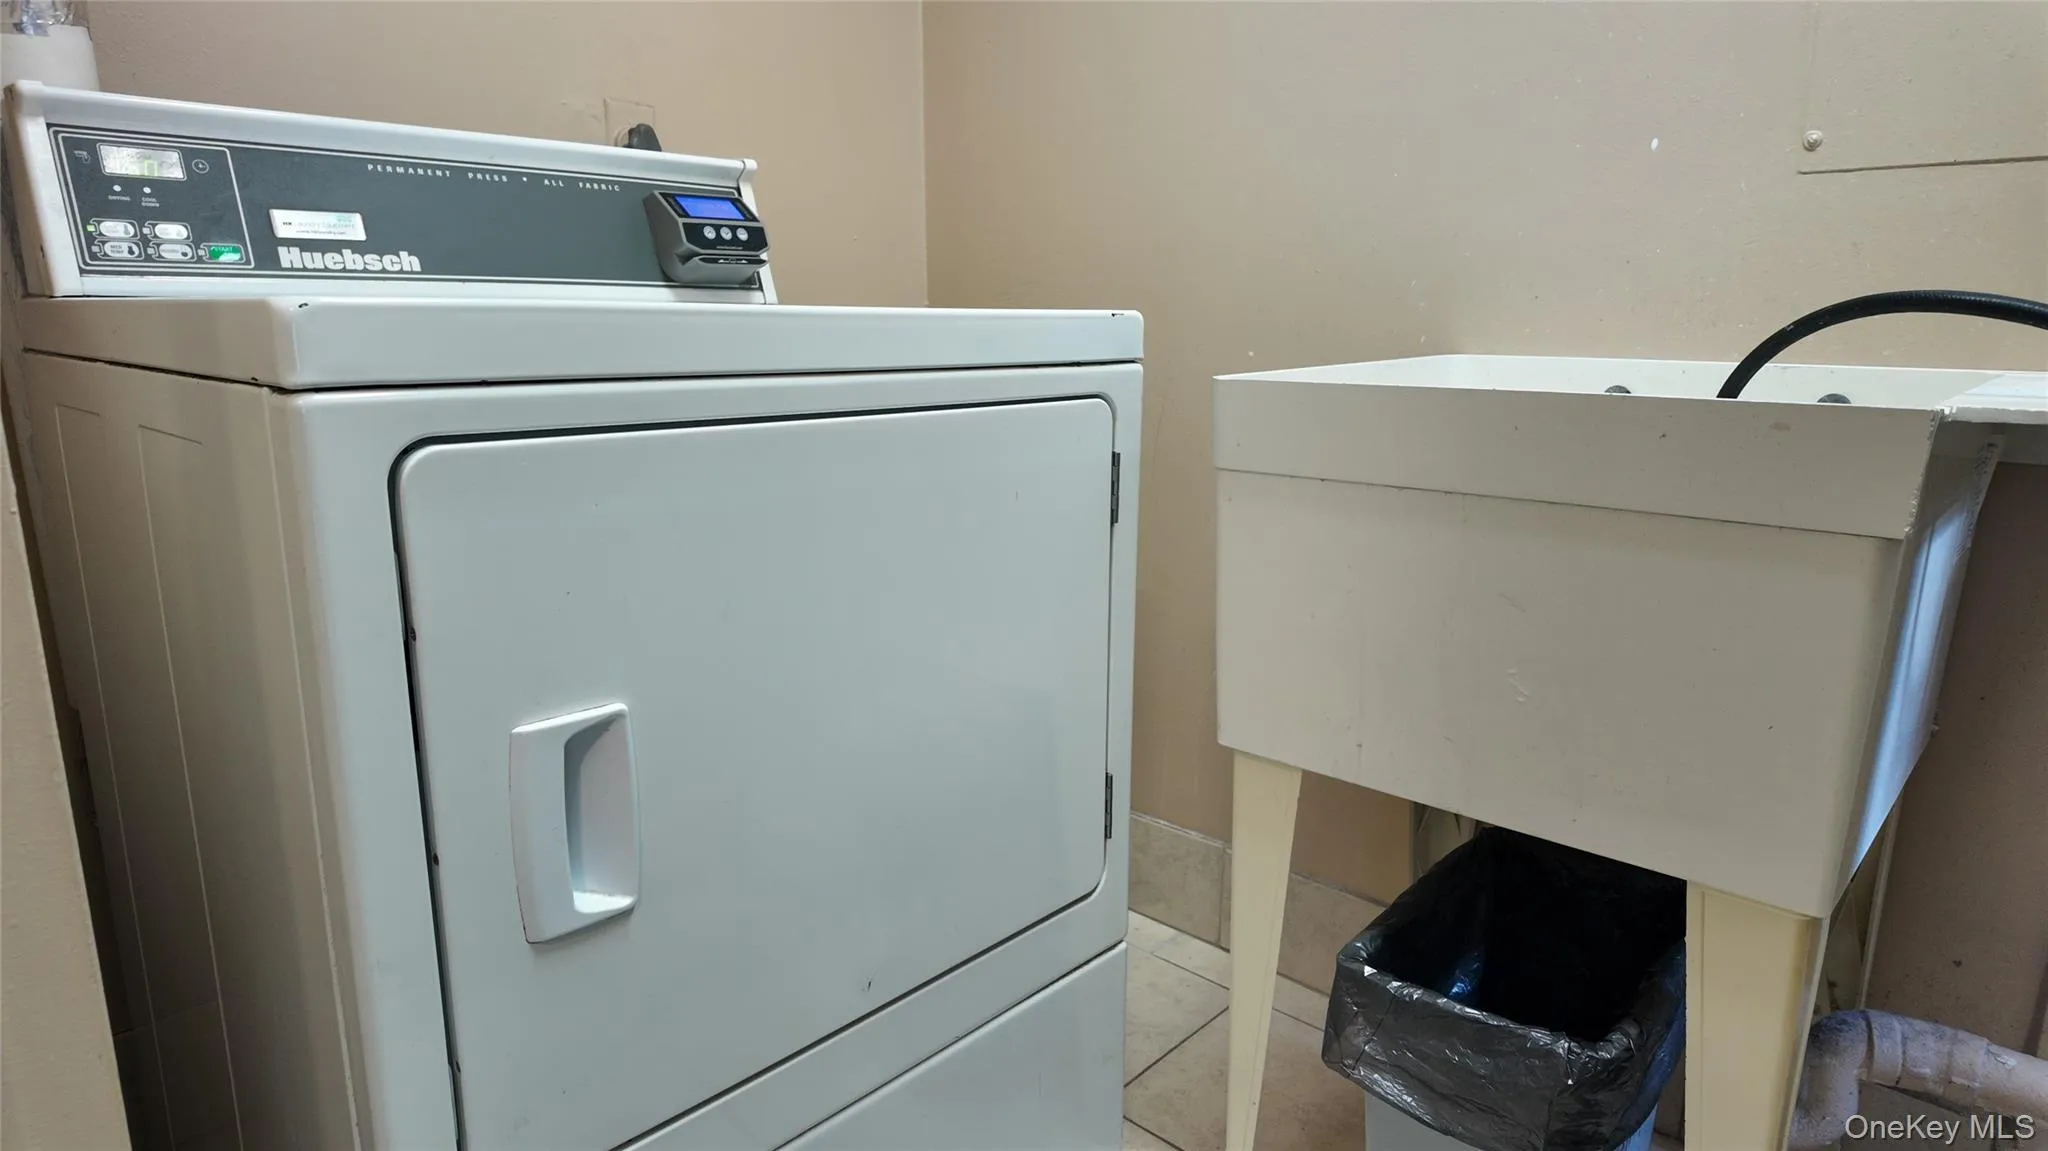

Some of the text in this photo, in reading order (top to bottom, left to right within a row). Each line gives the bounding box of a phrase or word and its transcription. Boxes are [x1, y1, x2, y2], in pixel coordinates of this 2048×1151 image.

[367, 163, 620, 192] PERMANENT PRESS ALL FABRIC
[277, 246, 422, 272] Huebsch
